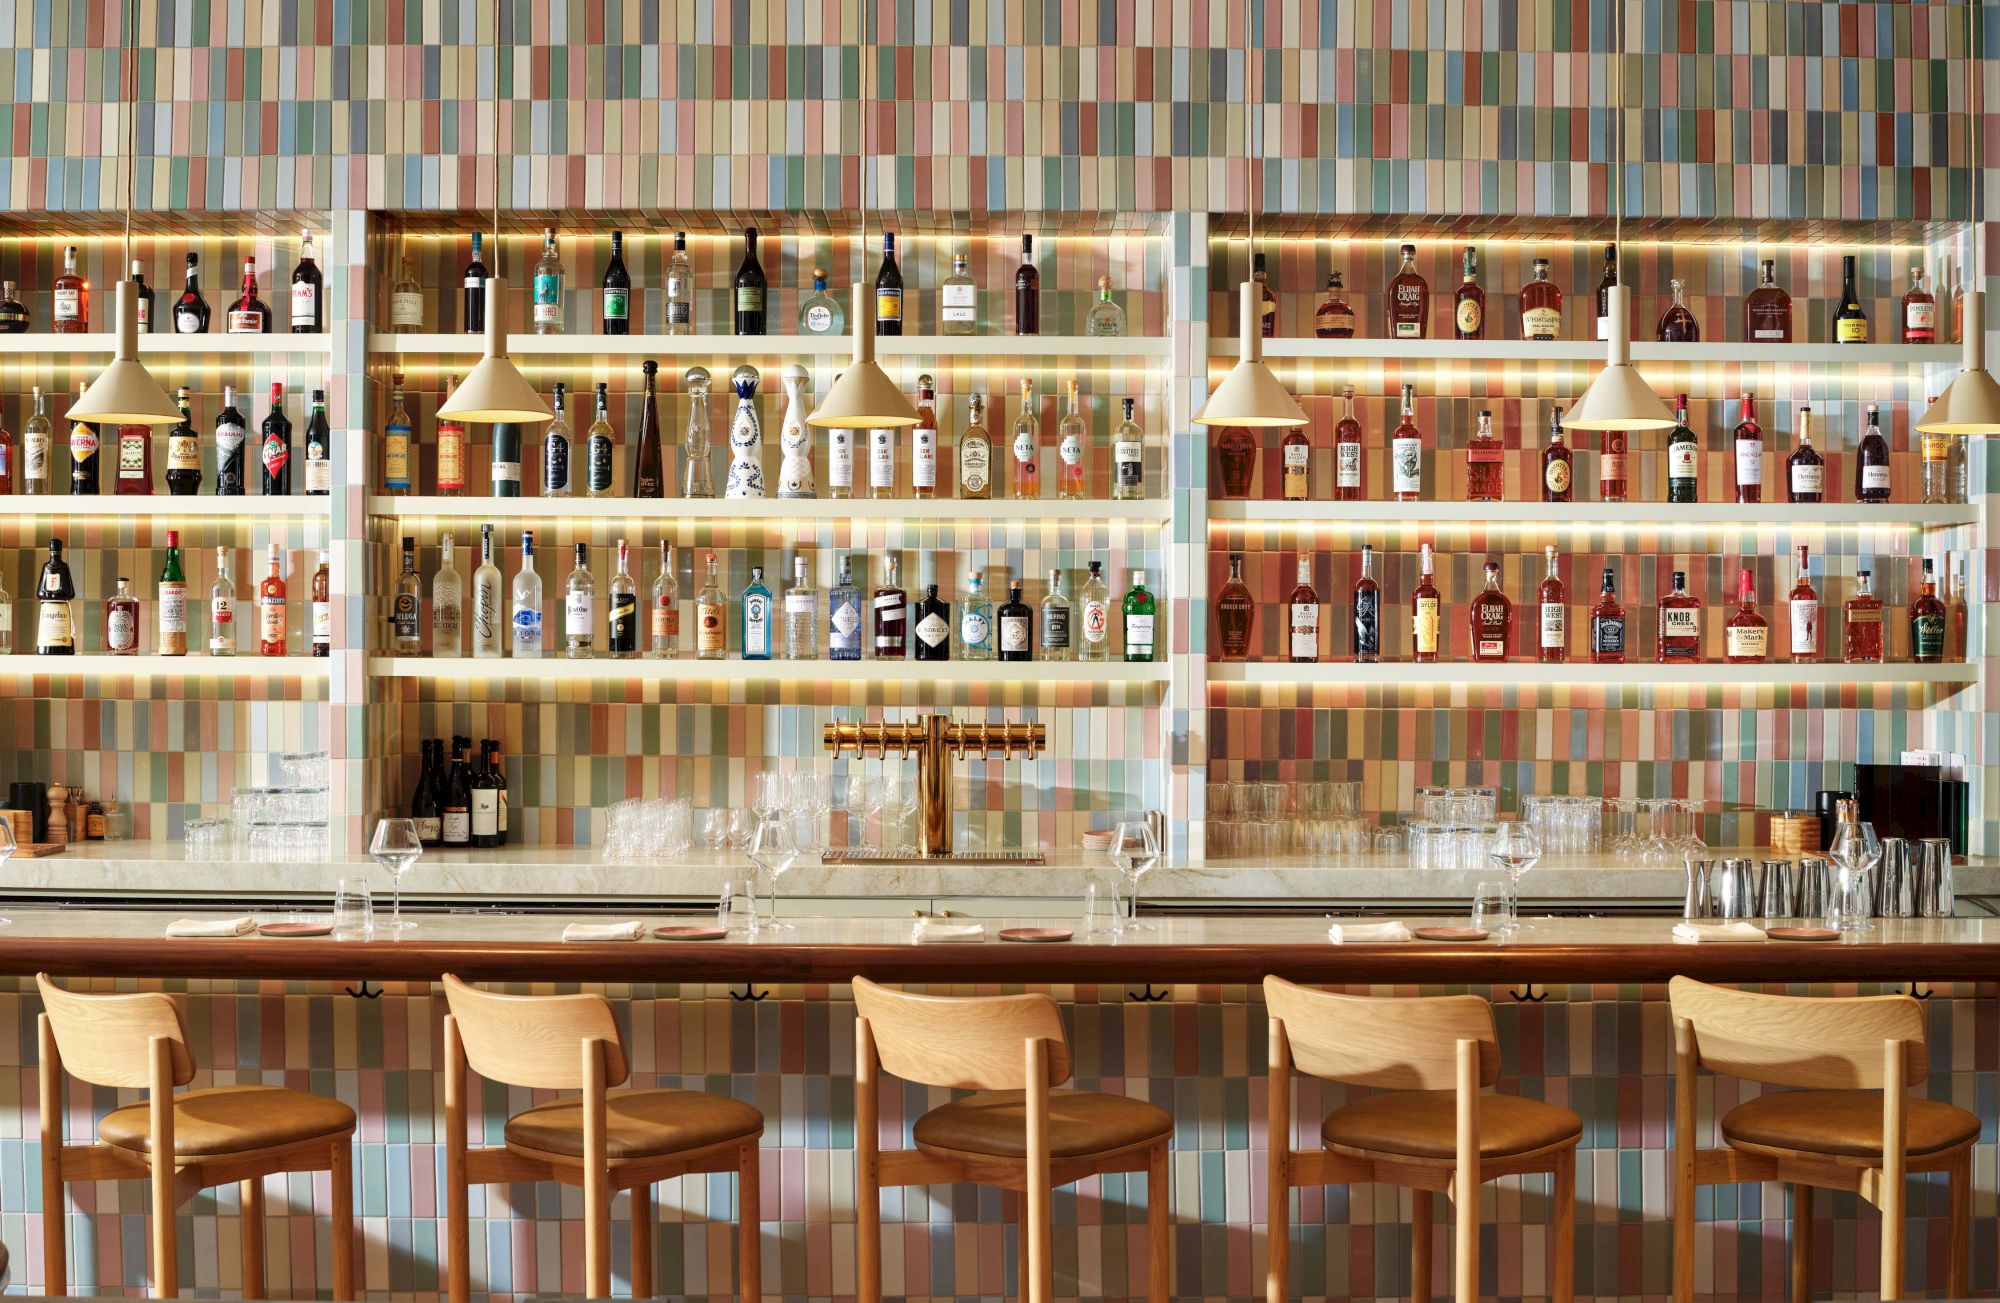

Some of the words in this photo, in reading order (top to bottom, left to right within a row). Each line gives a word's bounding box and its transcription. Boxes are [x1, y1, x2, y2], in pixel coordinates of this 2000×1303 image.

[1398, 284, 1420, 293] ELIJAH
[1397, 292, 1420, 302] CRAIG
[477, 580, 492, 639] Chopin
[1480, 604, 1504, 613] ELIJAH
[1480, 611, 1504, 621] CRAIG
[1667, 611, 1690, 622] KNOB
[433, 622, 458, 630] BELEDERE
[1919, 622, 1944, 635] Weller
